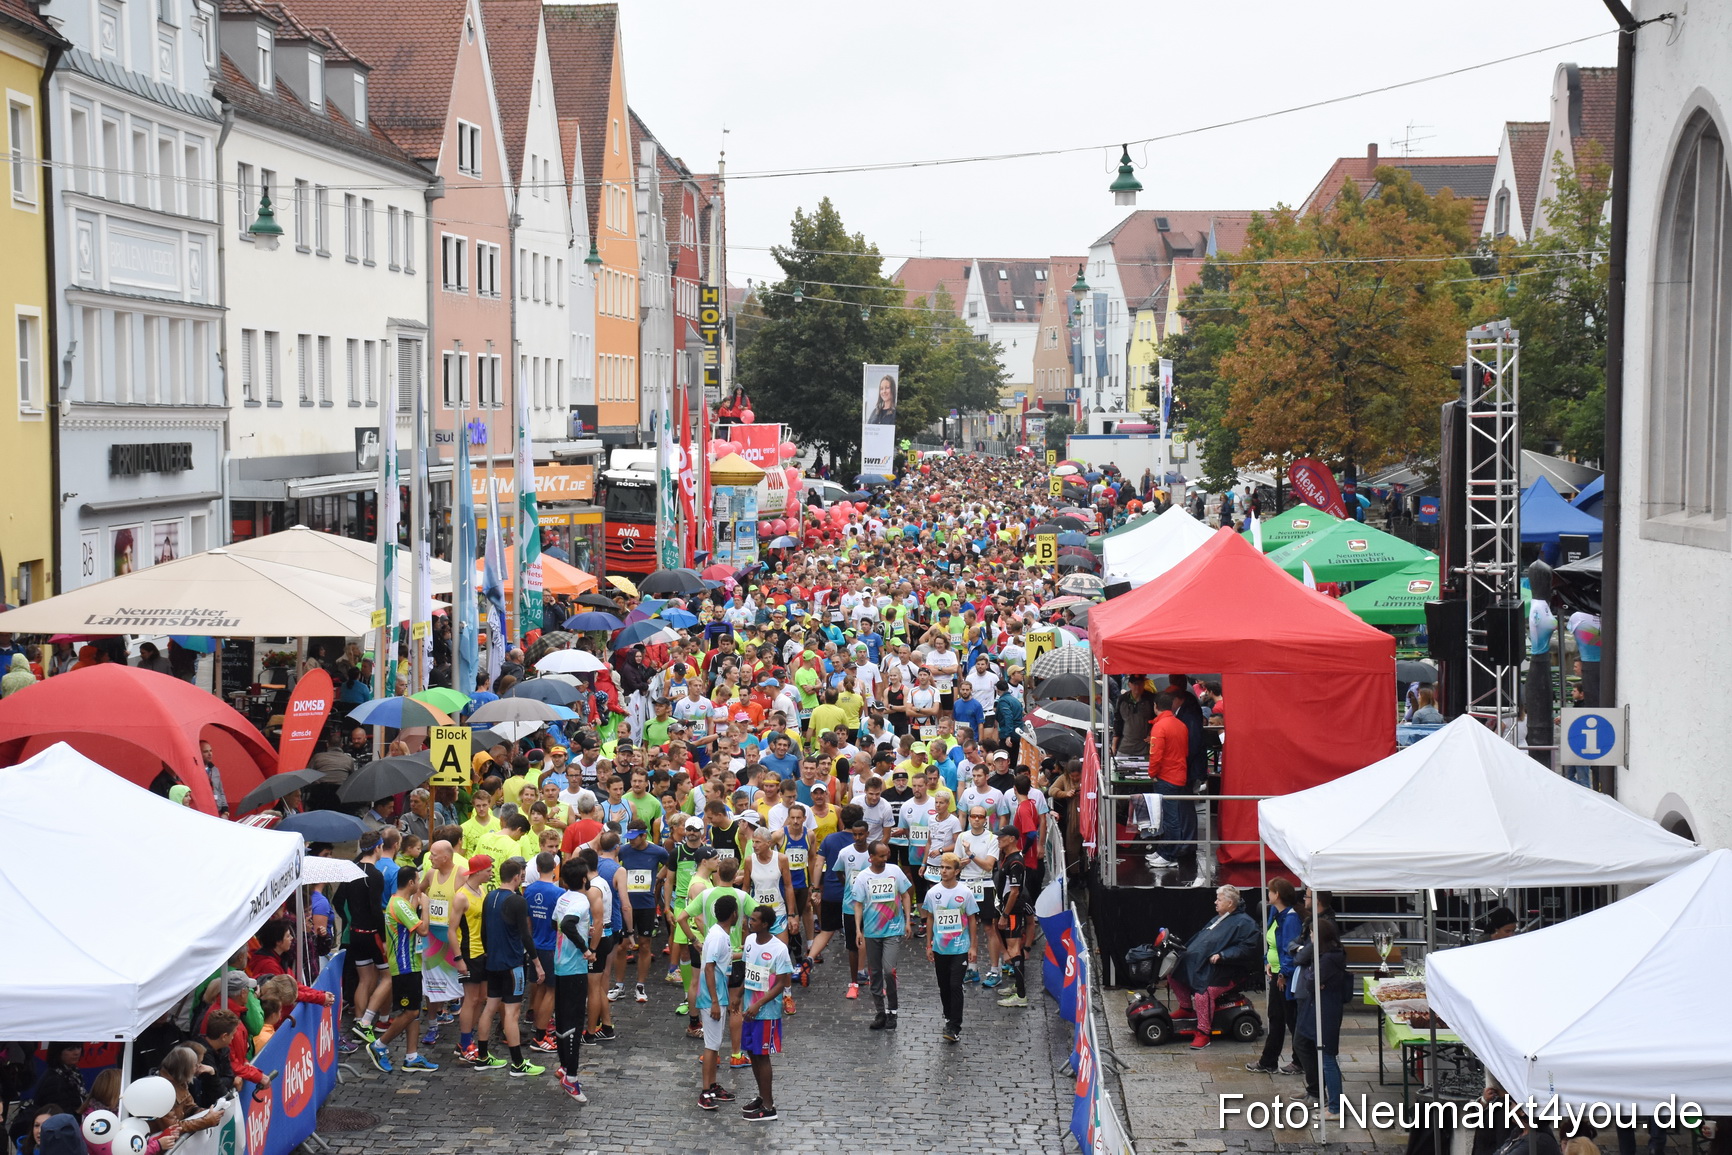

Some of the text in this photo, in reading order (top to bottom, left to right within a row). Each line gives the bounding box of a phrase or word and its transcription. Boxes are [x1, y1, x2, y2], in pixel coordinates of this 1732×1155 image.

[701, 288, 719, 384] HOTEL
[116, 442, 194, 476] BRILLEN WEBER
[911, 453, 916, 463] D
[765, 472, 785, 491] AVIA
[1295, 468, 1326, 505] Hervis
[1052, 483, 1060, 493] C
[617, 527, 640, 537] AVIA
[1041, 543, 1053, 559] B
[1328, 556, 1395, 564] Lammsbräu
[115, 607, 228, 617] Neumarkter
[84, 614, 241, 628] Lammsbräu
[1028, 634, 1052, 642] Block
[293, 700, 318, 712] DKMS
[291, 730, 312, 738] dkms.de
[436, 728, 467, 740] Block
[438, 744, 462, 773] A
[911, 830, 928, 839] 2011
[790, 853, 804, 863] 153
[634, 874, 646, 884] 99
[871, 883, 893, 894] 2722
[759, 893, 775, 904] 268
[430, 905, 443, 917] 500
[938, 914, 959, 925] 2737
[284, 1047, 314, 1102] Hervis
[247, 1095, 272, 1155] Hervis
